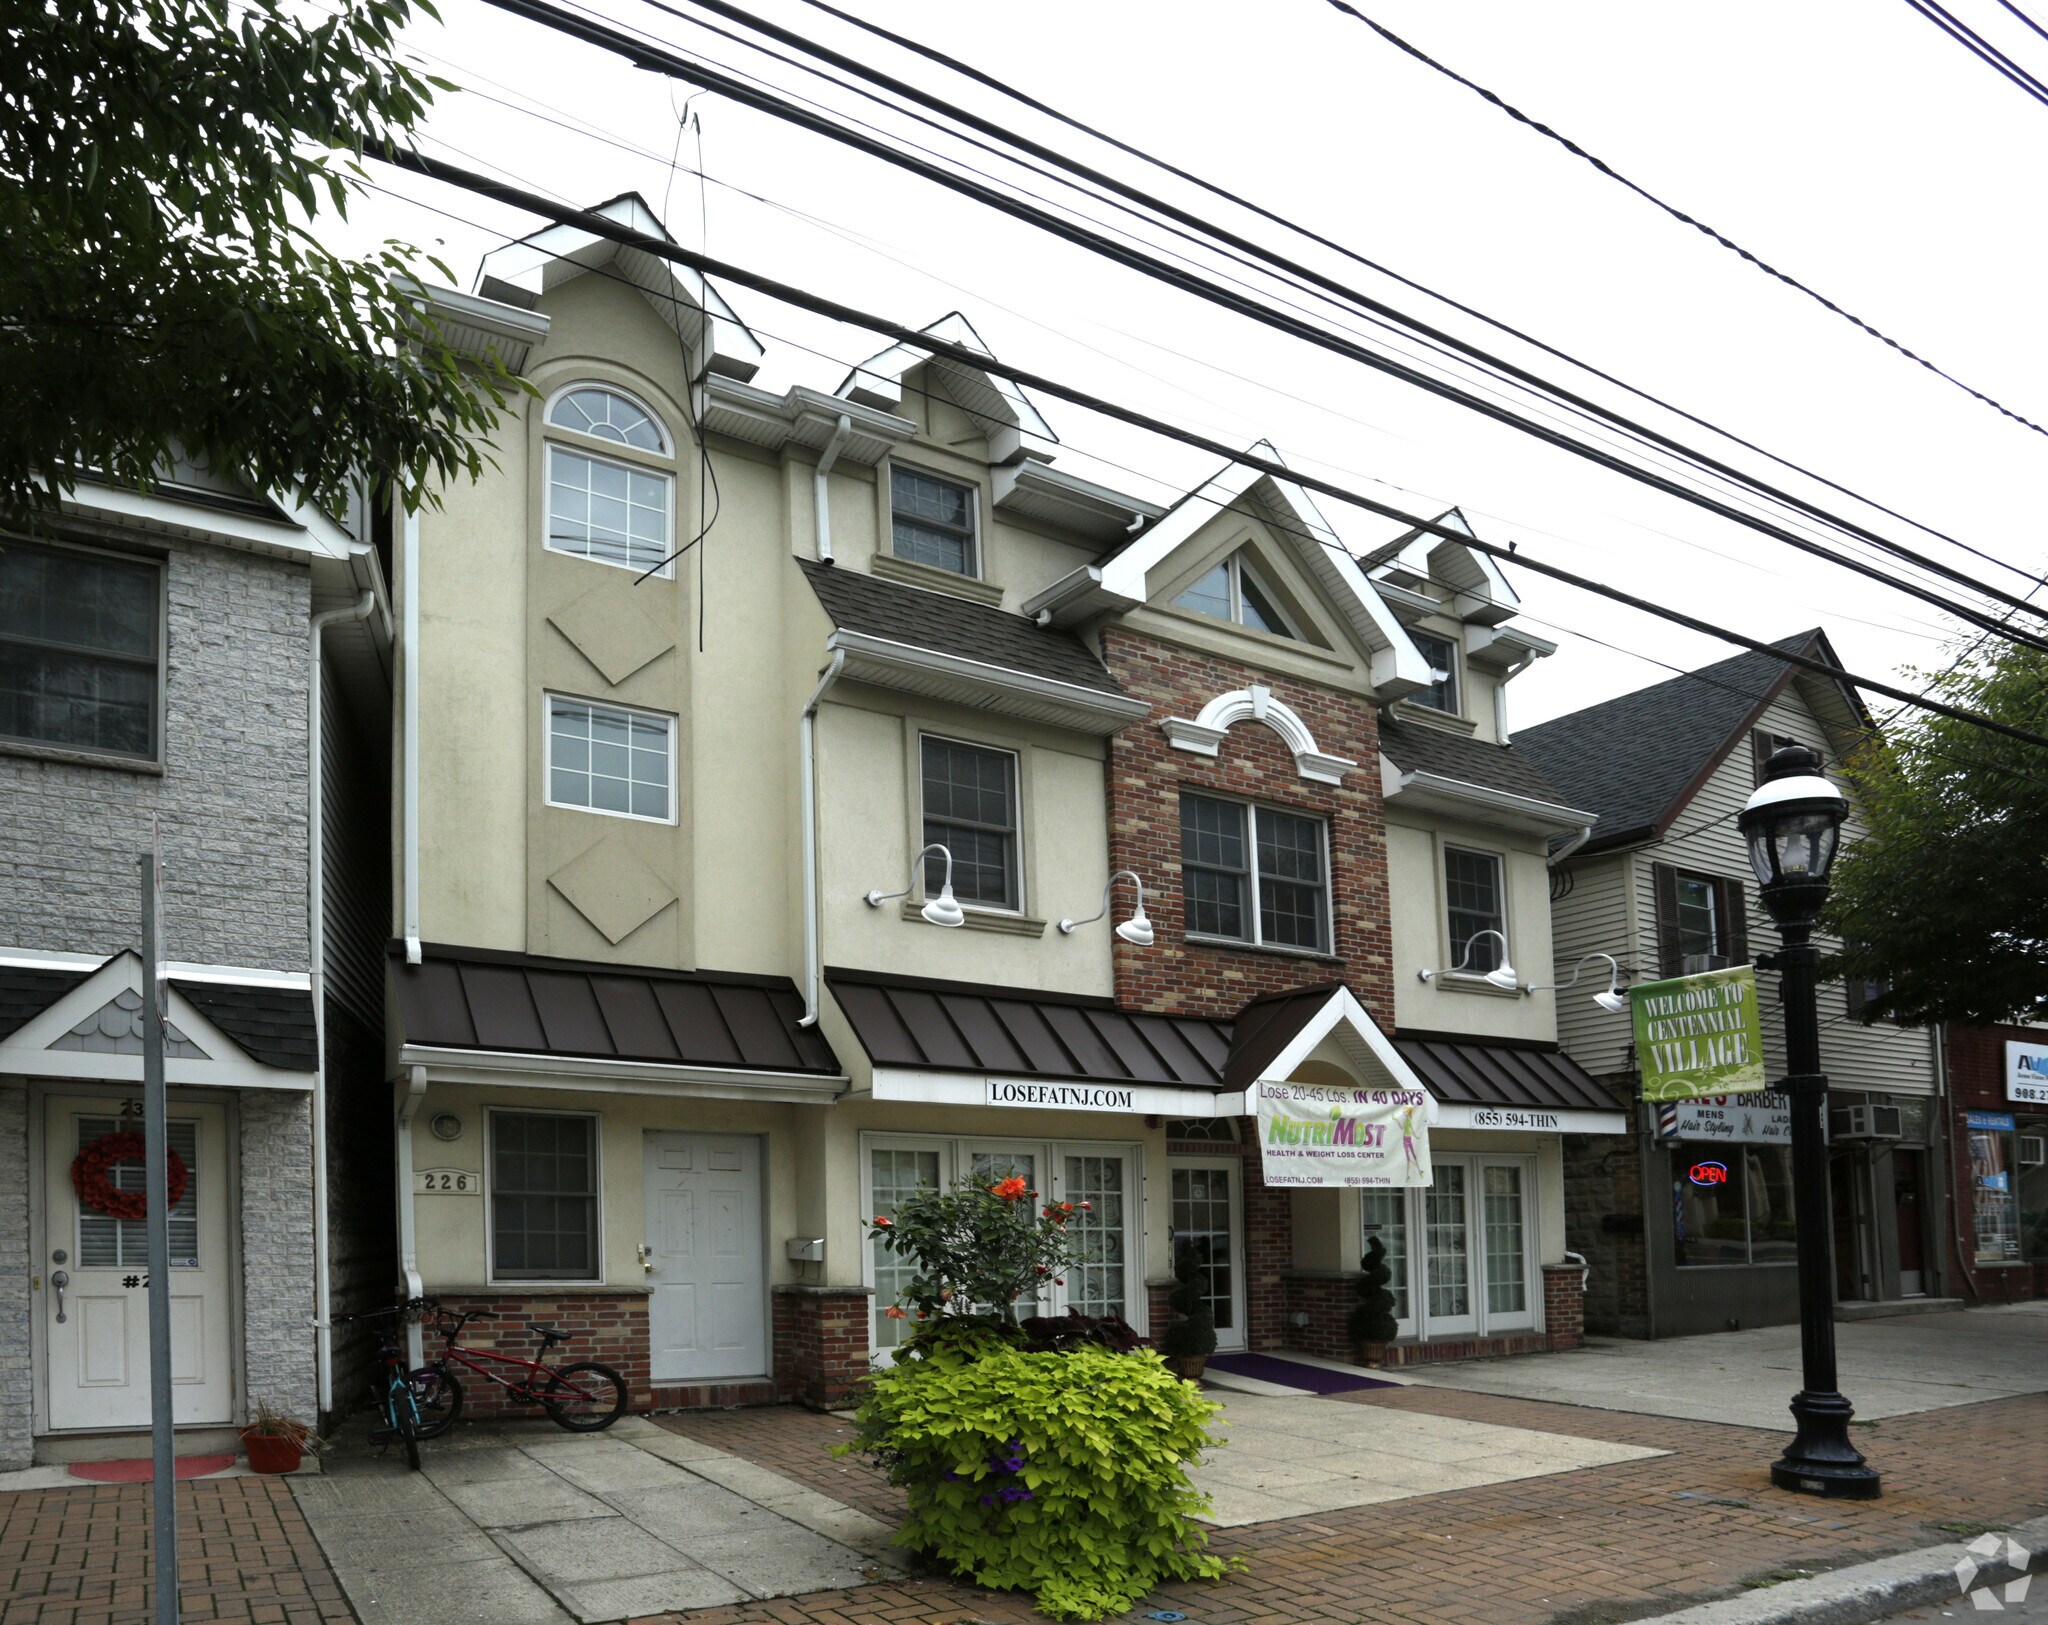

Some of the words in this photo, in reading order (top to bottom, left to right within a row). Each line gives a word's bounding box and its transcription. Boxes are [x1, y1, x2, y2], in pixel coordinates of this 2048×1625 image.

[1645, 988, 1719, 1018] WELCOME
[1721, 983, 1743, 1005] TO
[1647, 1008, 1746, 1042] CENTENNIAL
[1650, 1032, 1750, 1074] VILLAGE
[991, 1083, 1132, 1108] LOSEFATNJ.COM
[1260, 1083, 1289, 1099] Lose
[1291, 1085, 1324, 1101] 20-45
[1326, 1088, 1350, 1103] Lbs.
[1354, 1090, 1369, 1104] IN
[1372, 1091, 1388, 1104] 40
[1391, 1091, 1424, 1106] DAYS
[1737, 1090, 1787, 1110] BARBER
[1474, 1112, 1502, 1126] (855)
[1505, 1113, 1558, 1128] 594-THIN
[1697, 1109, 1724, 1120] MENS
[1771, 1115, 1791, 1124] LADI
[1681, 1119, 1701, 1132] Hair
[1703, 1121, 1735, 1137] Styling
[1762, 1124, 1780, 1136] Hair
[1266, 1149, 1296, 1157] HEALTH
[425, 1174, 467, 1190] 226
[1266, 1176, 1323, 1184] LOSEFATNJ.COM
[1690, 1165, 1727, 1183] OPEN
